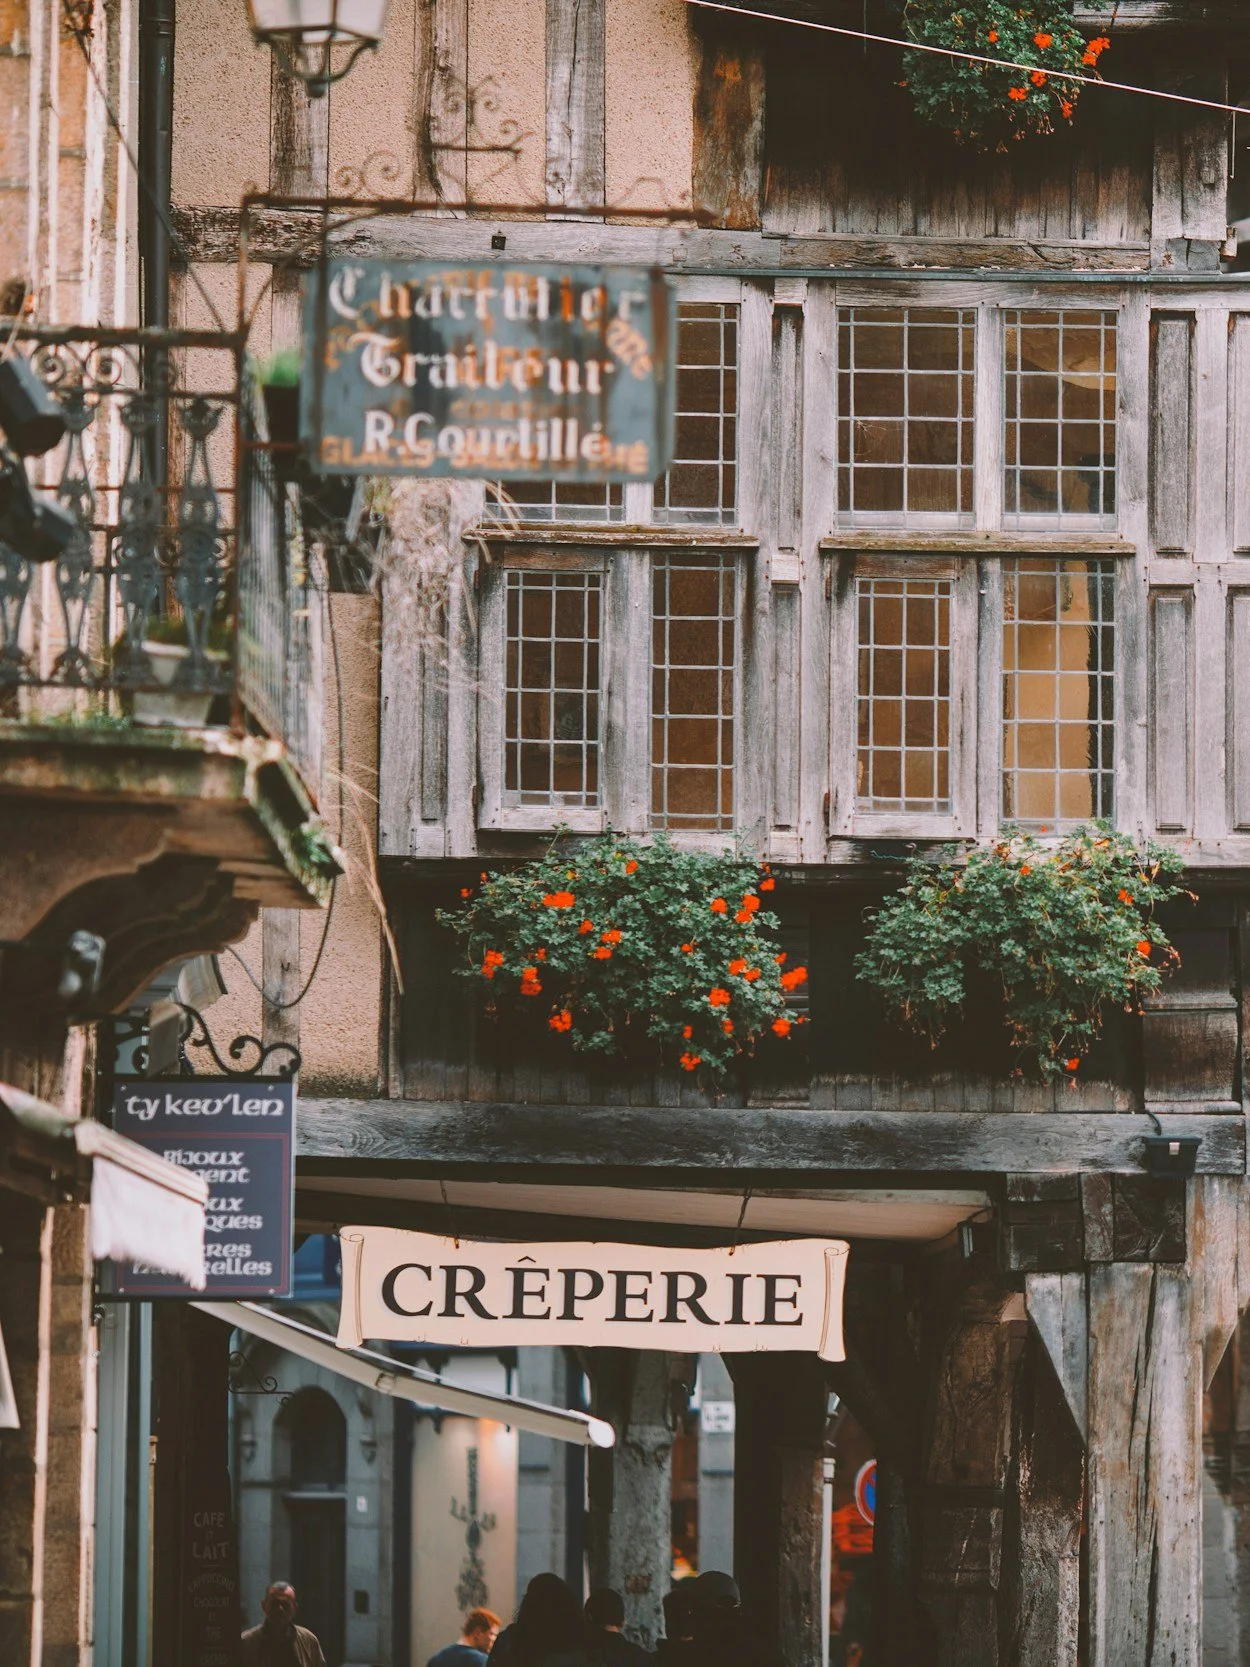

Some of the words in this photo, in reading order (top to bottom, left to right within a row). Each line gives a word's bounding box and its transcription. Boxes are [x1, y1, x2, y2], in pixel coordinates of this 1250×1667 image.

[347, 331, 615, 395] Traiteur
[125, 1095, 160, 1121] ty
[381, 1255, 804, 1327] CRÊPERIE
[192, 1541, 230, 1560] LAIT
